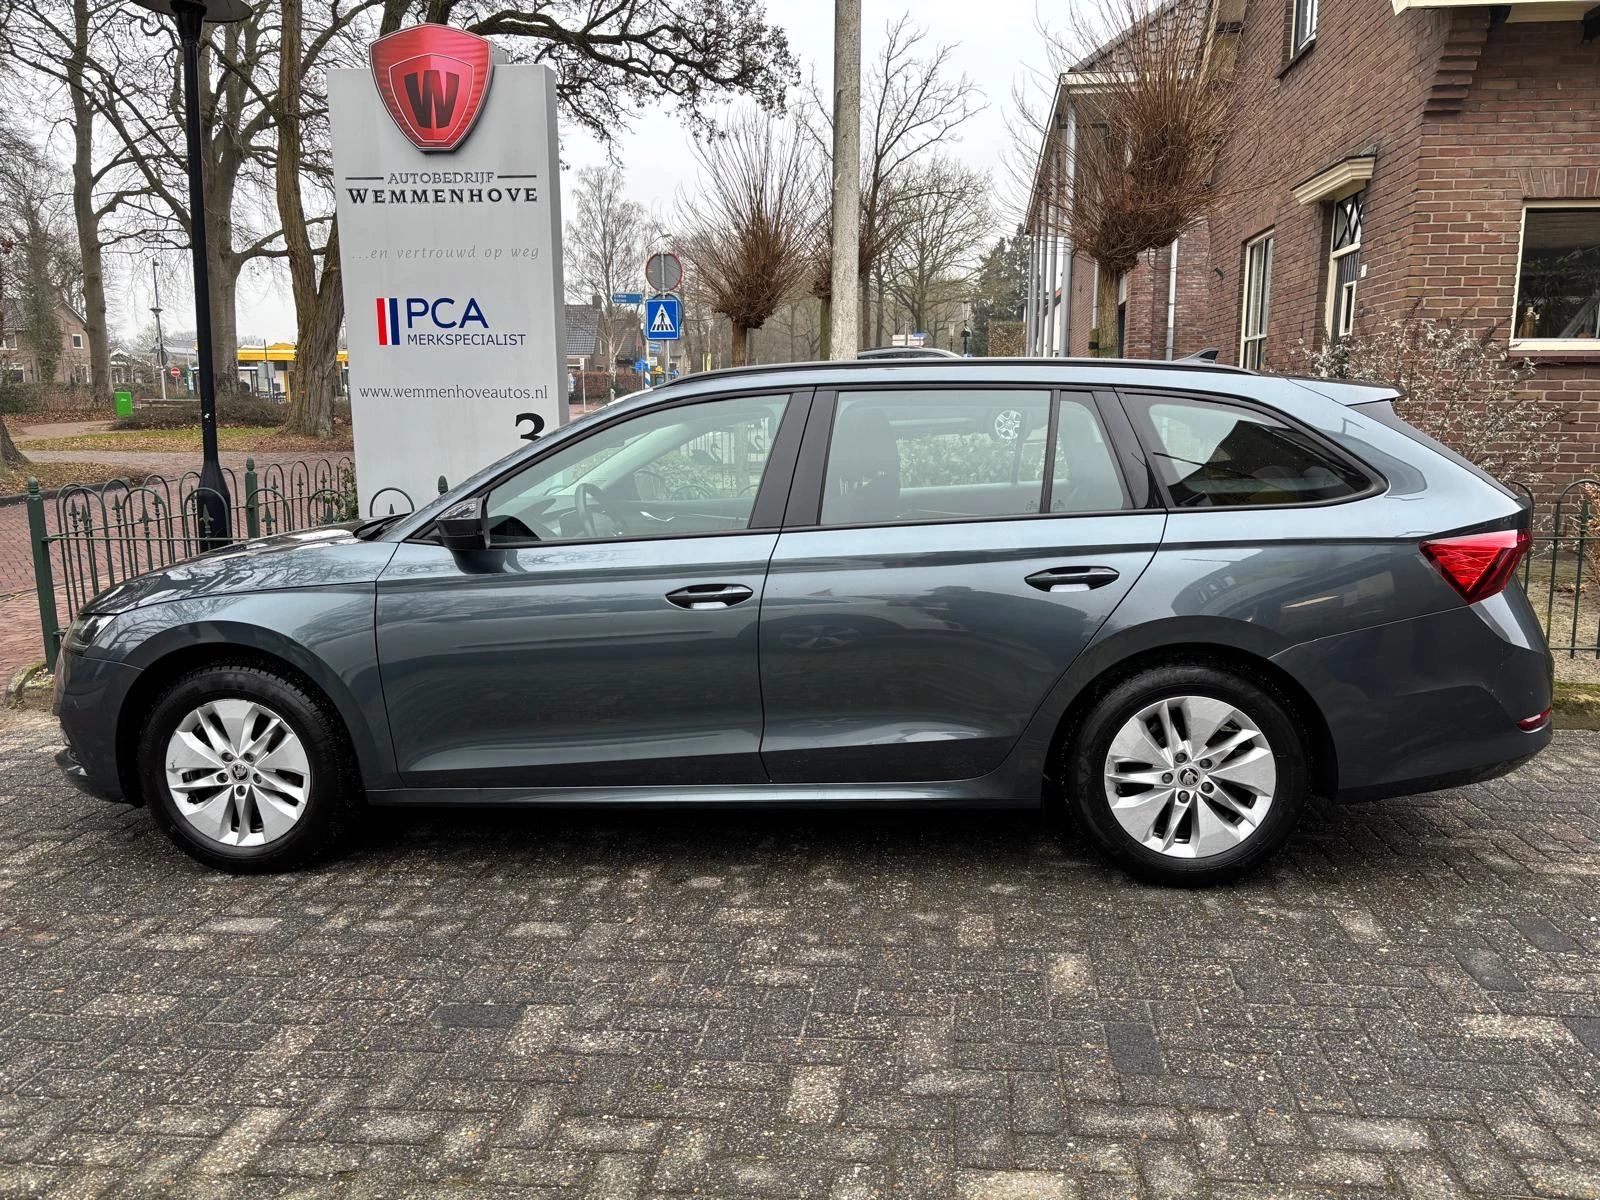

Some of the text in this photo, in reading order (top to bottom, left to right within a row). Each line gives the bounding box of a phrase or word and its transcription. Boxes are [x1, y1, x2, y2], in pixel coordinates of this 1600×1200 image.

[388, 172, 495, 185] AUTOBEDRIJF
[346, 188, 538, 204] WEMMENHOVE
[397, 245, 476, 259] vertrouwd
[484, 248, 502, 260] op
[511, 247, 539, 260] weg
[406, 297, 489, 329] PCA
[407, 333, 526, 346] MERKSPECIALIST
[359, 385, 548, 400] www.wemmenhoveautos.nl
